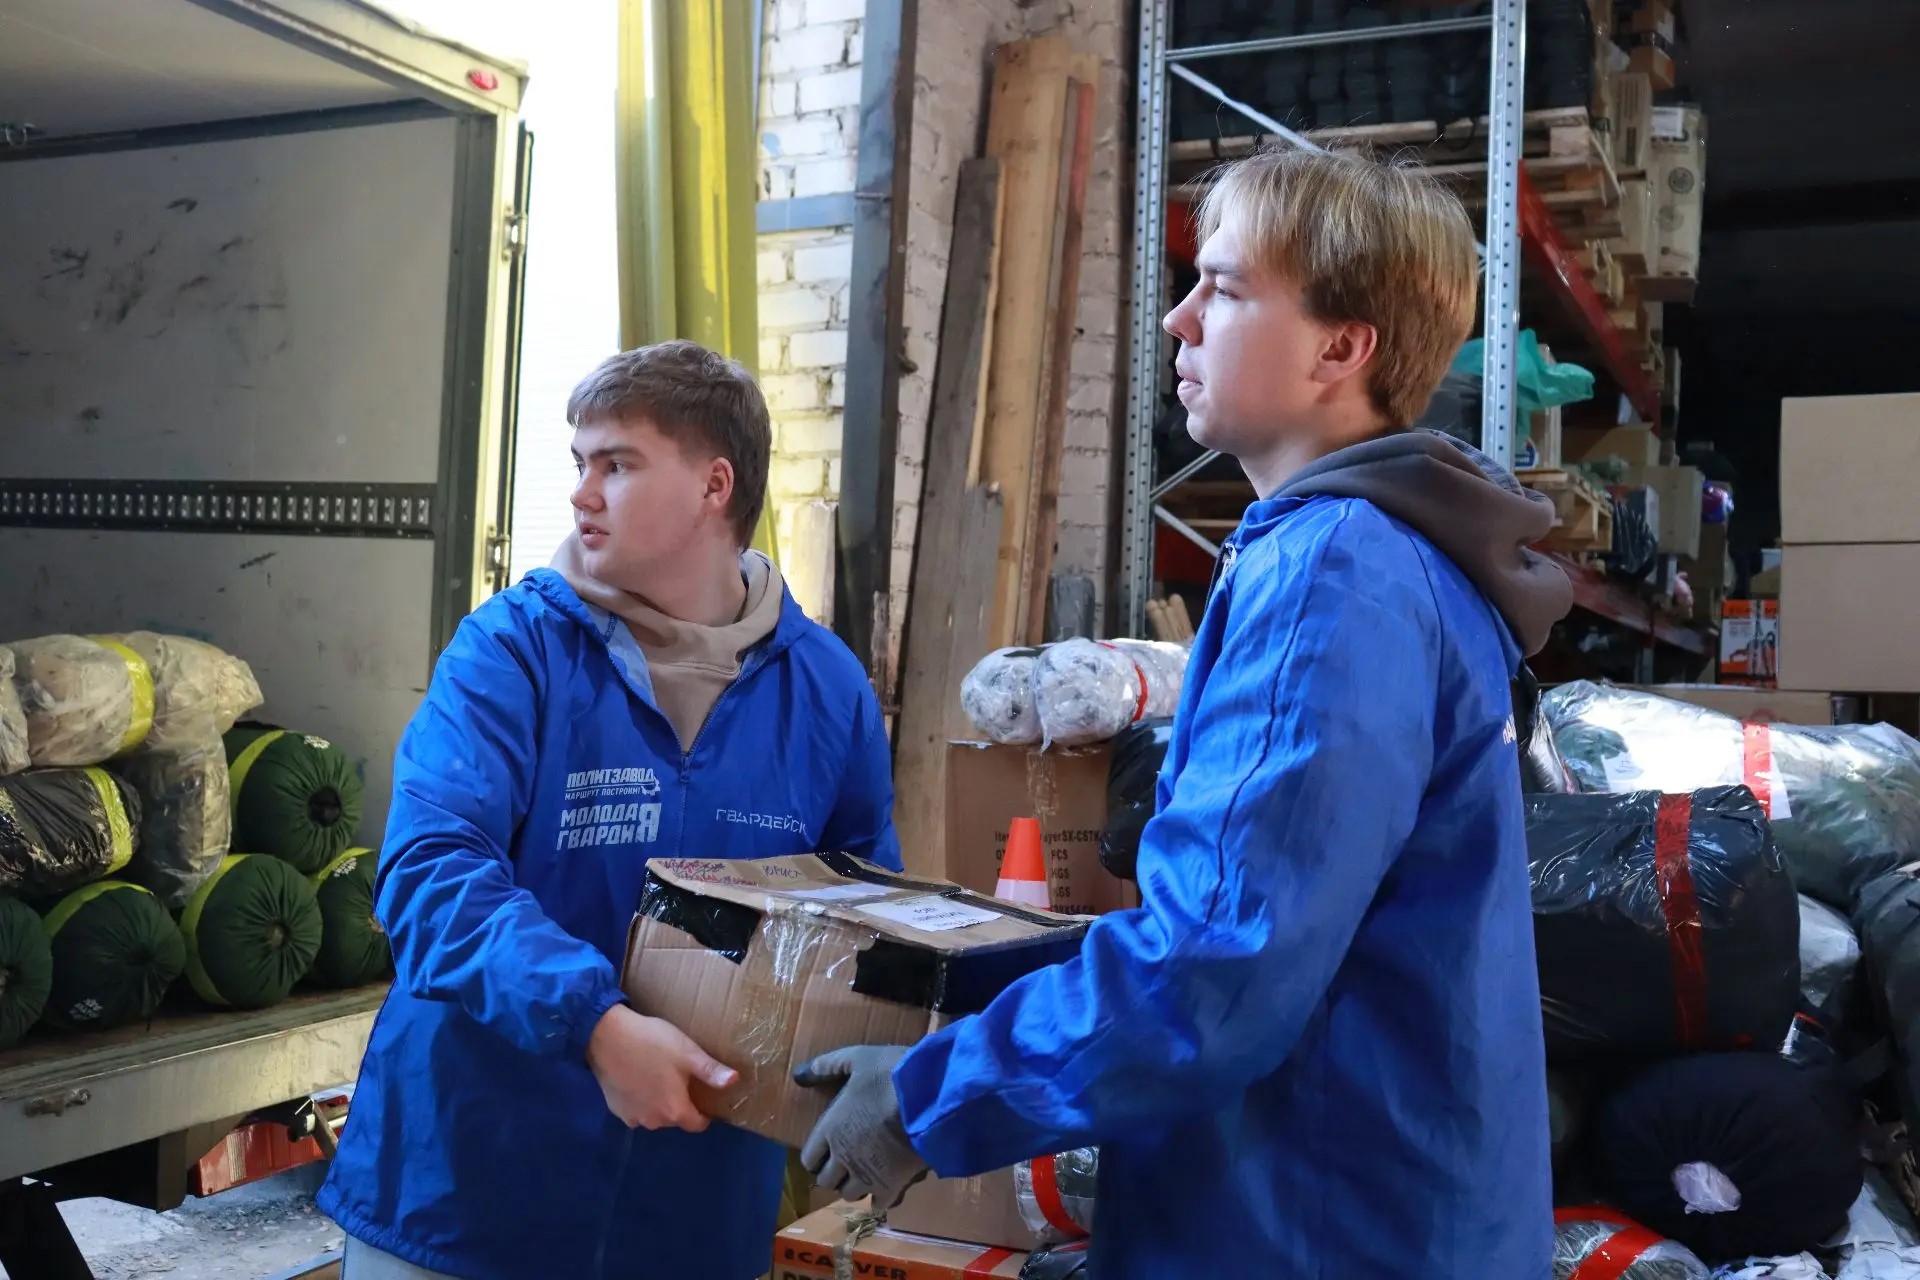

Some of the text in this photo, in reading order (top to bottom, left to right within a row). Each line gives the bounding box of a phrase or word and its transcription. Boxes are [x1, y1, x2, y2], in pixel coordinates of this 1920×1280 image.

[566, 768, 656, 788] ПОЛИТЗАВОД
[565, 789, 600, 800] МАРШРУТ
[797, 1251, 907, 1280] CAVER
